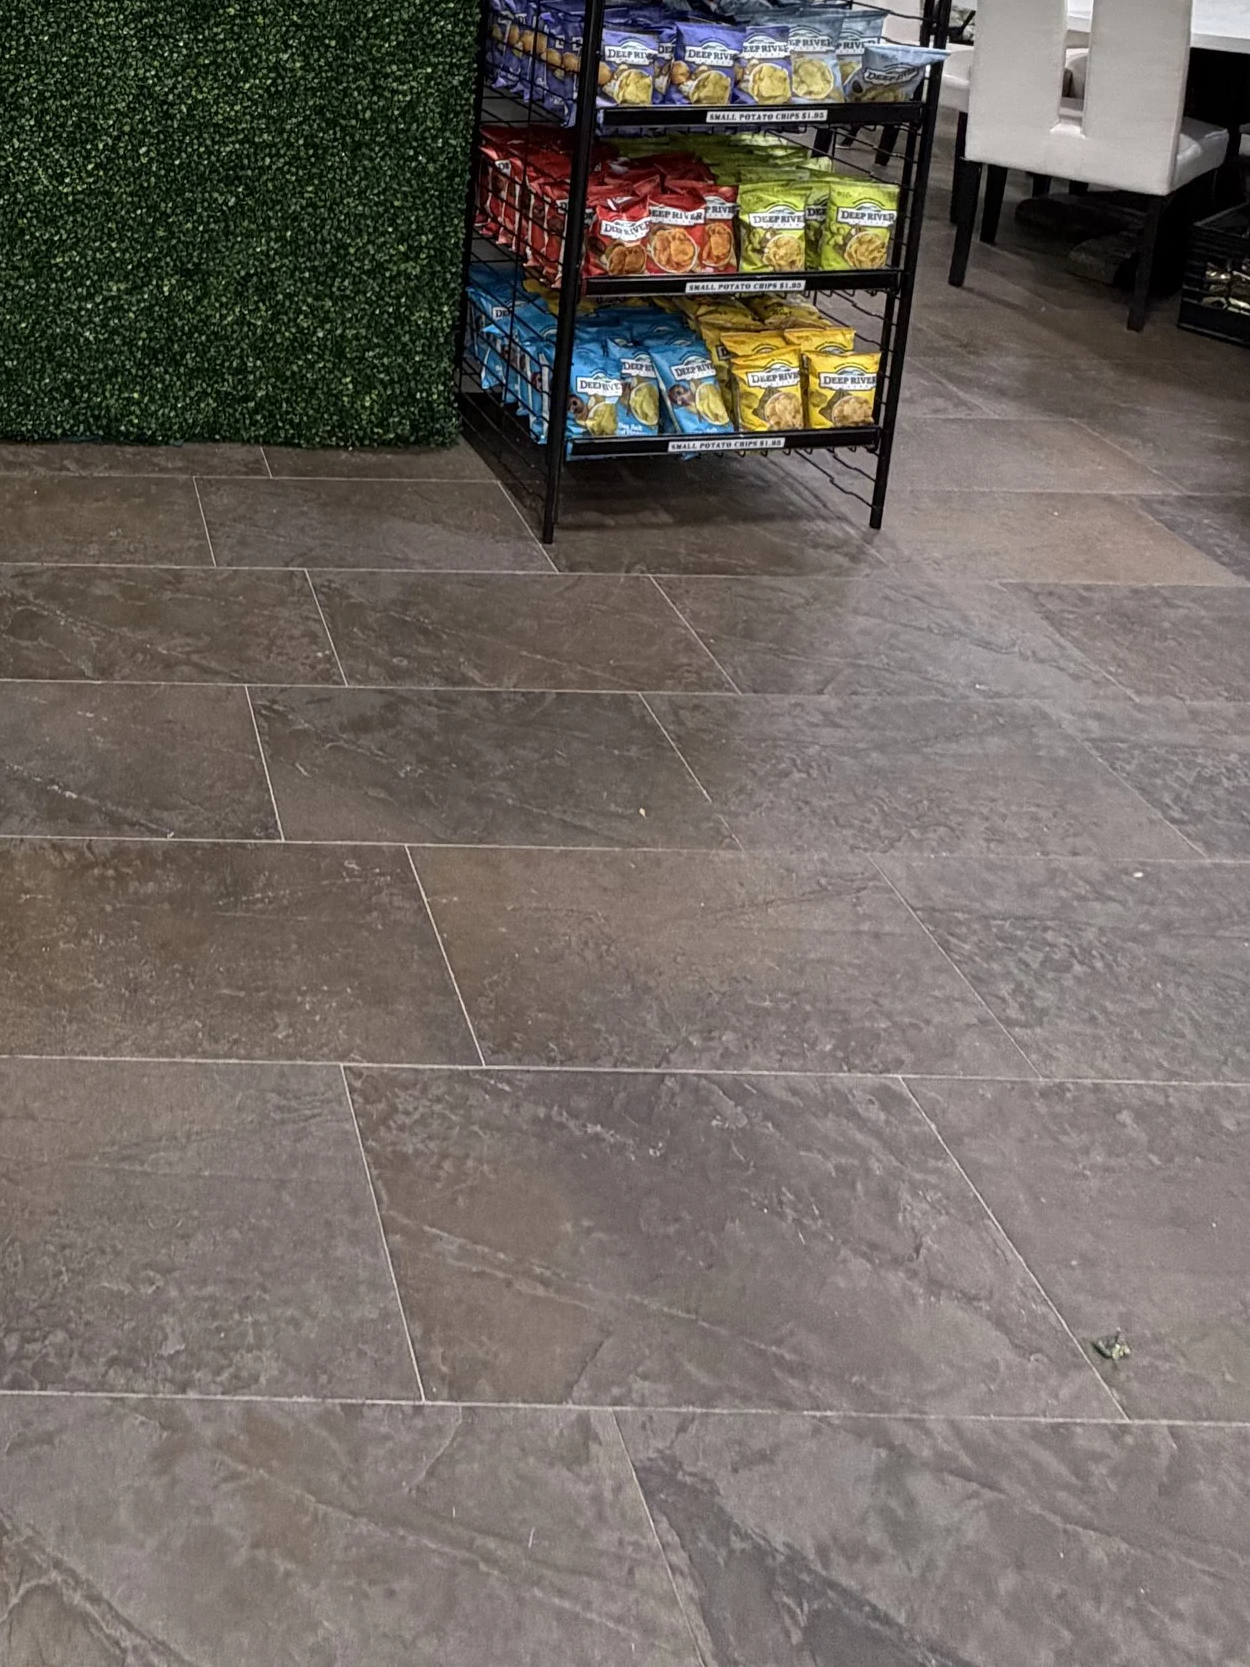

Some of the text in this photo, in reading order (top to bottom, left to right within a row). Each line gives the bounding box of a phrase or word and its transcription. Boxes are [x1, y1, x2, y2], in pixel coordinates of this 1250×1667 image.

[744, 44, 761, 53] EEP
[607, 49, 631, 59] DEEP
[688, 49, 735, 60] DEEP RIVE
[867, 71, 893, 81] DEEP
[709, 113, 737, 122] SMALL
[739, 113, 774, 121] POTATO
[775, 112, 800, 121] CHIPS
[651, 209, 670, 219] EEP
[753, 214, 804, 224] DEEP RIVE
[841, 210, 895, 222] DEEP RIVER
[689, 284, 716, 292] SMALL
[718, 283, 751, 291] POTATO
[753, 282, 778, 291] CHIPS
[623, 361, 644, 372] DEEP
[675, 363, 715, 377] DEEP RIVE
[751, 371, 799, 383] DEEP RIVE
[823, 375, 849, 385] DEEP
[671, 442, 698, 451] SMALL
[699, 441, 732, 450] POTATO
[733, 440, 758, 449] CHIPS
